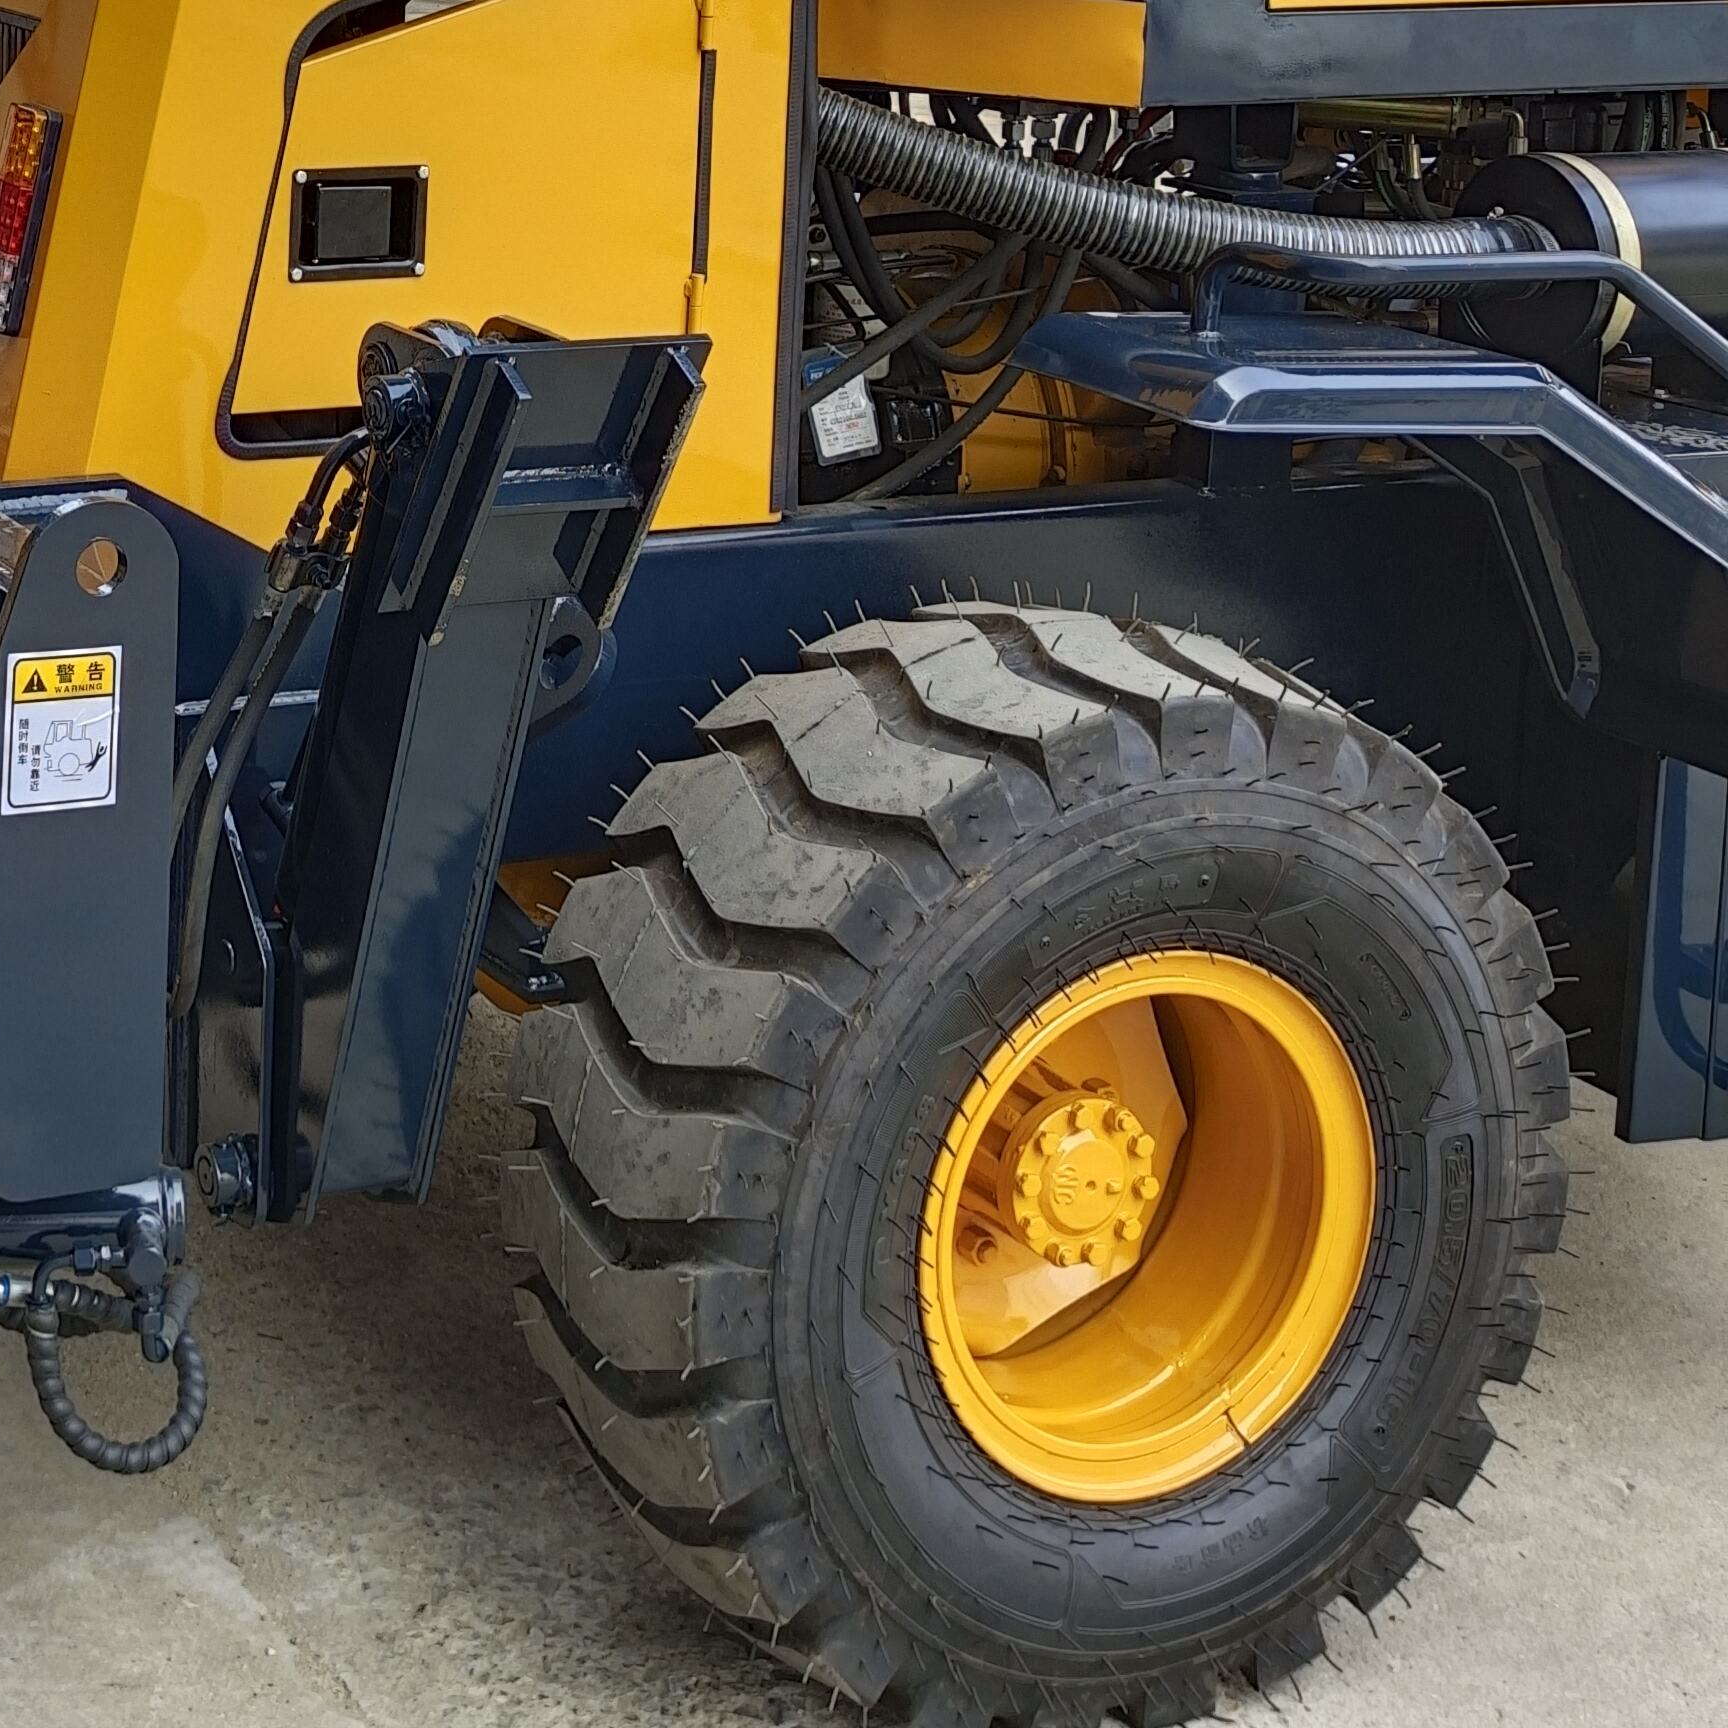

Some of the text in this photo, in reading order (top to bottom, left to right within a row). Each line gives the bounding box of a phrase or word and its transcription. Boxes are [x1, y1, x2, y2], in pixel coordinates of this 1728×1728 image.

[54, 683, 103, 693] WARNING
[56, 661, 105, 683] 警告
[17, 718, 29, 765] 随时倒车
[30, 744, 41, 791] 请勿靠近
